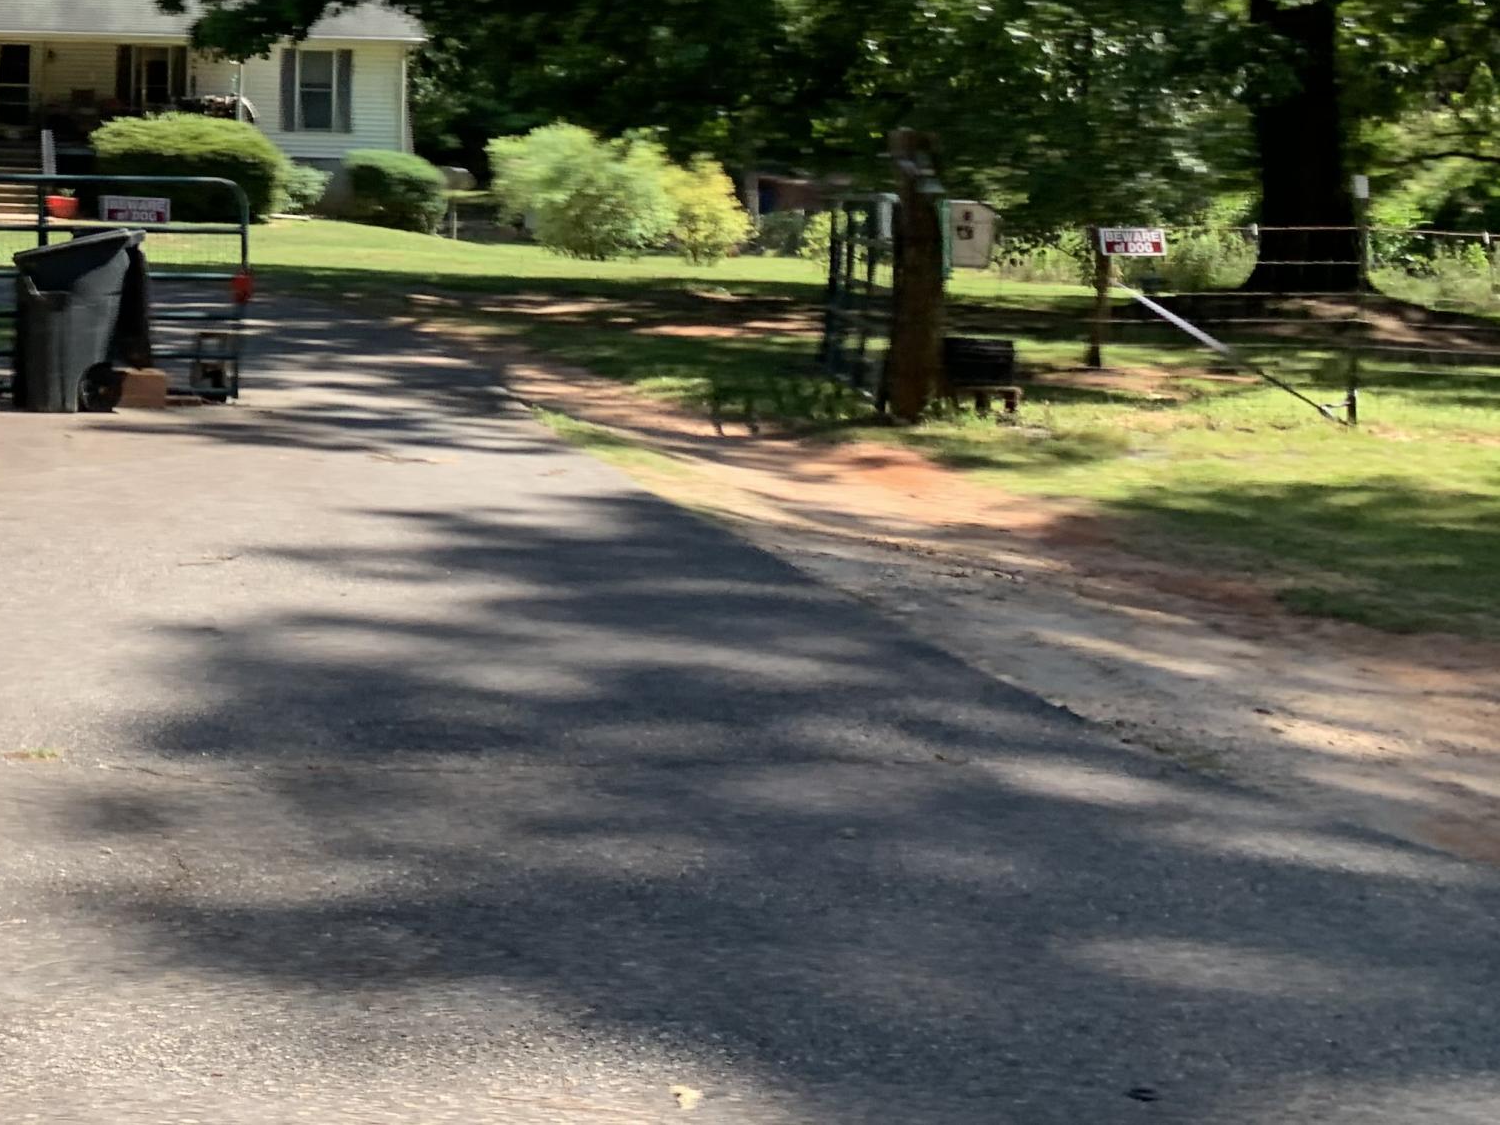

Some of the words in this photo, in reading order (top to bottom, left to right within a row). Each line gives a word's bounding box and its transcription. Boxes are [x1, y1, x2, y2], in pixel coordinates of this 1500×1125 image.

[105, 200, 166, 211] BEWARE
[132, 211, 158, 222] DOG
[1105, 231, 1160, 242] BEWARE
[1114, 243, 1125, 253] of
[1127, 242, 1155, 253] DOG
